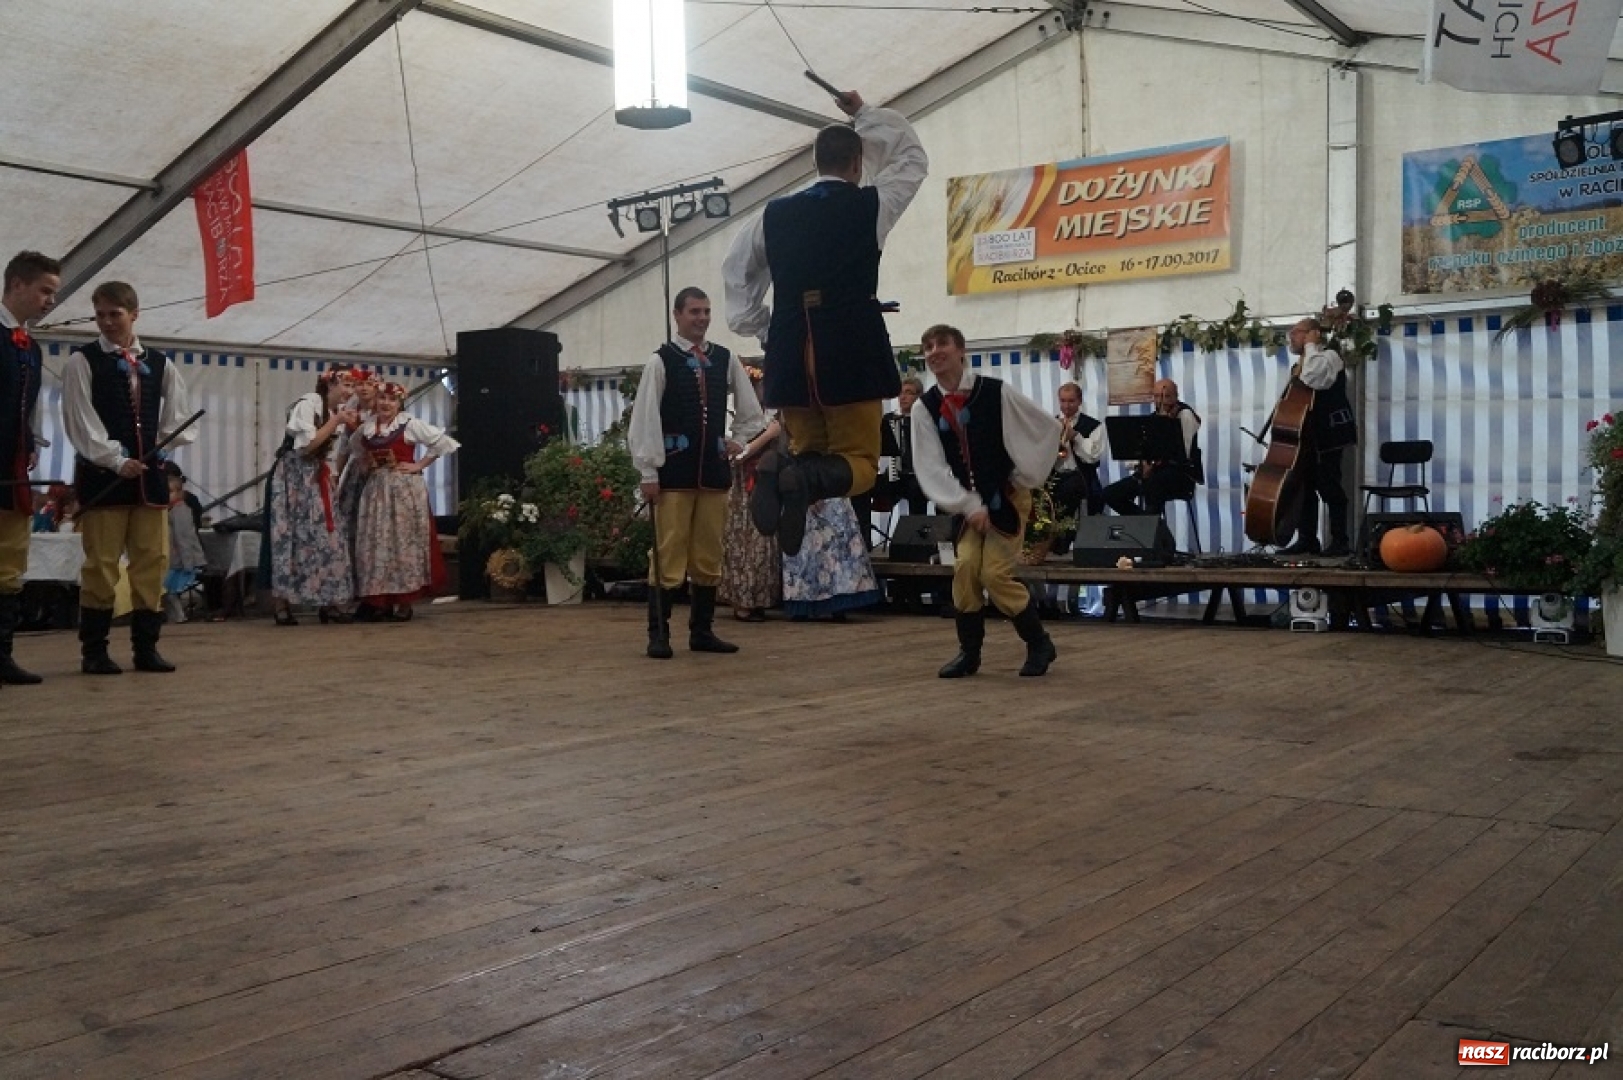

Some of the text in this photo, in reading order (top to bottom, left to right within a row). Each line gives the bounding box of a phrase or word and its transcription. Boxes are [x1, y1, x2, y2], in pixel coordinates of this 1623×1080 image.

[1057, 161, 1215, 206] DOŻYNKI
[1456, 197, 1482, 210] RSP
[1054, 199, 1213, 241] MIEJSKIE
[1519, 215, 1605, 242] producent
[1013, 230, 1032, 243] LAT
